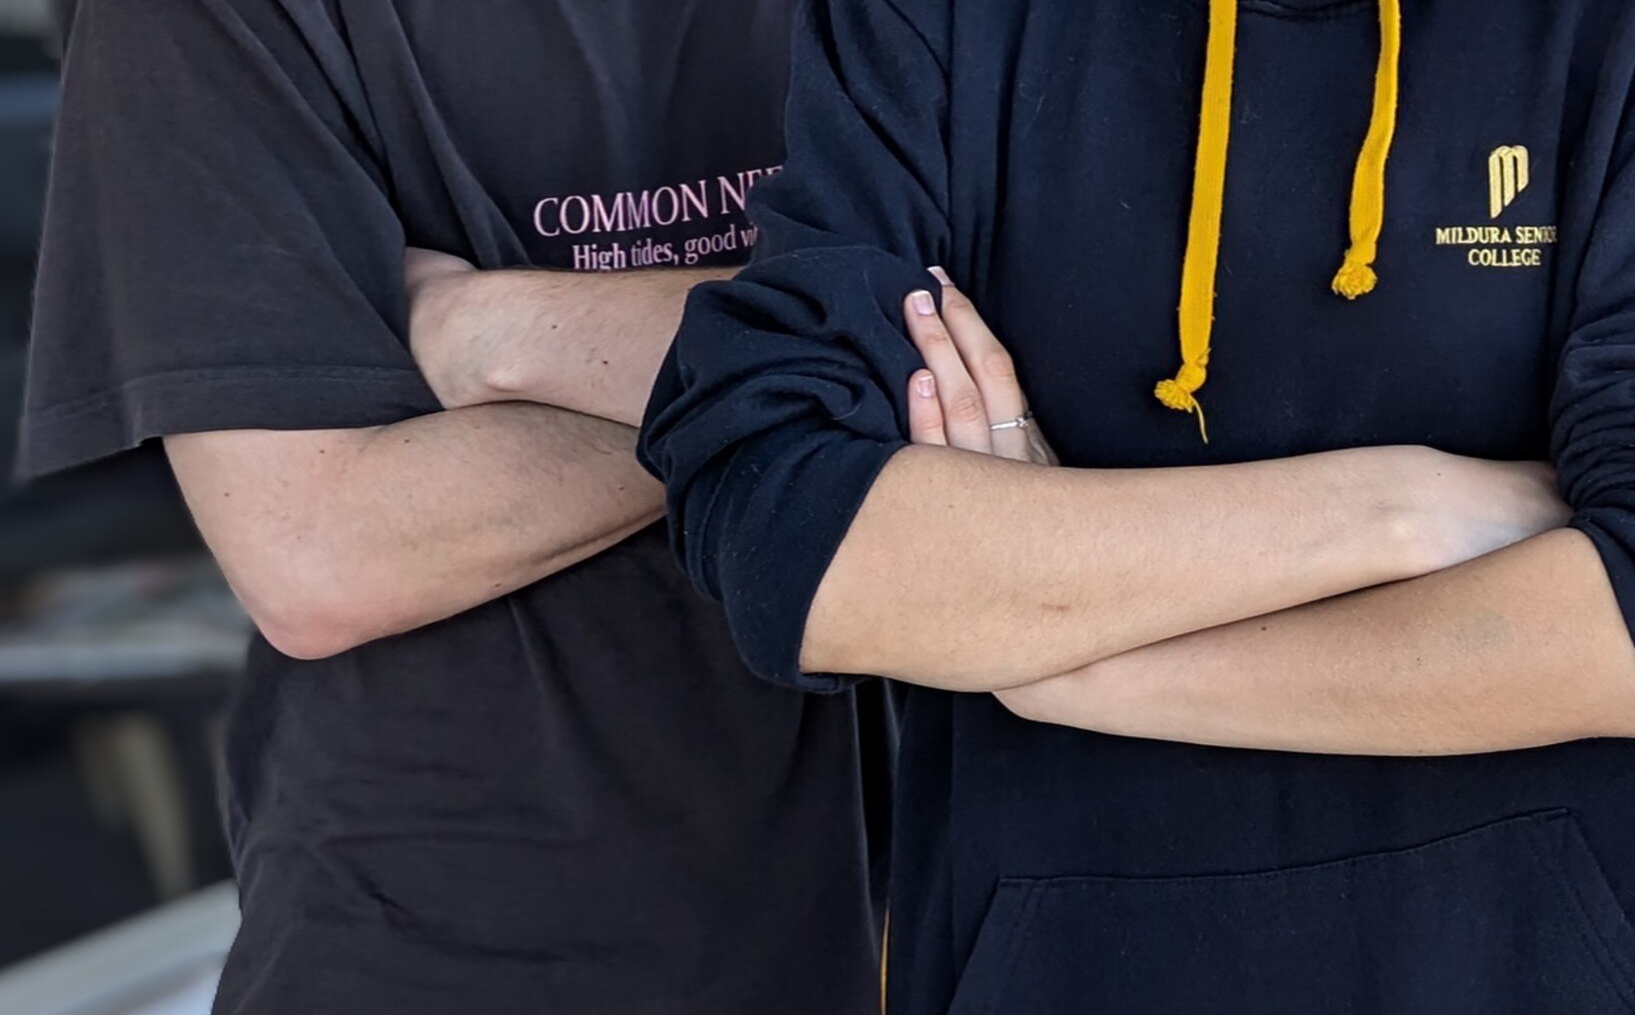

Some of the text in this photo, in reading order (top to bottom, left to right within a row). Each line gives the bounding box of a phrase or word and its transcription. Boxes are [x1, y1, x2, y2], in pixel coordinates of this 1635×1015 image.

[533, 180, 707, 237] COMMON
[572, 242, 627, 271] High
[631, 238, 680, 266] tides,
[685, 223, 737, 263] good
[1435, 226, 1512, 245] MILDURA
[1468, 248, 1542, 267] COLLEGE
